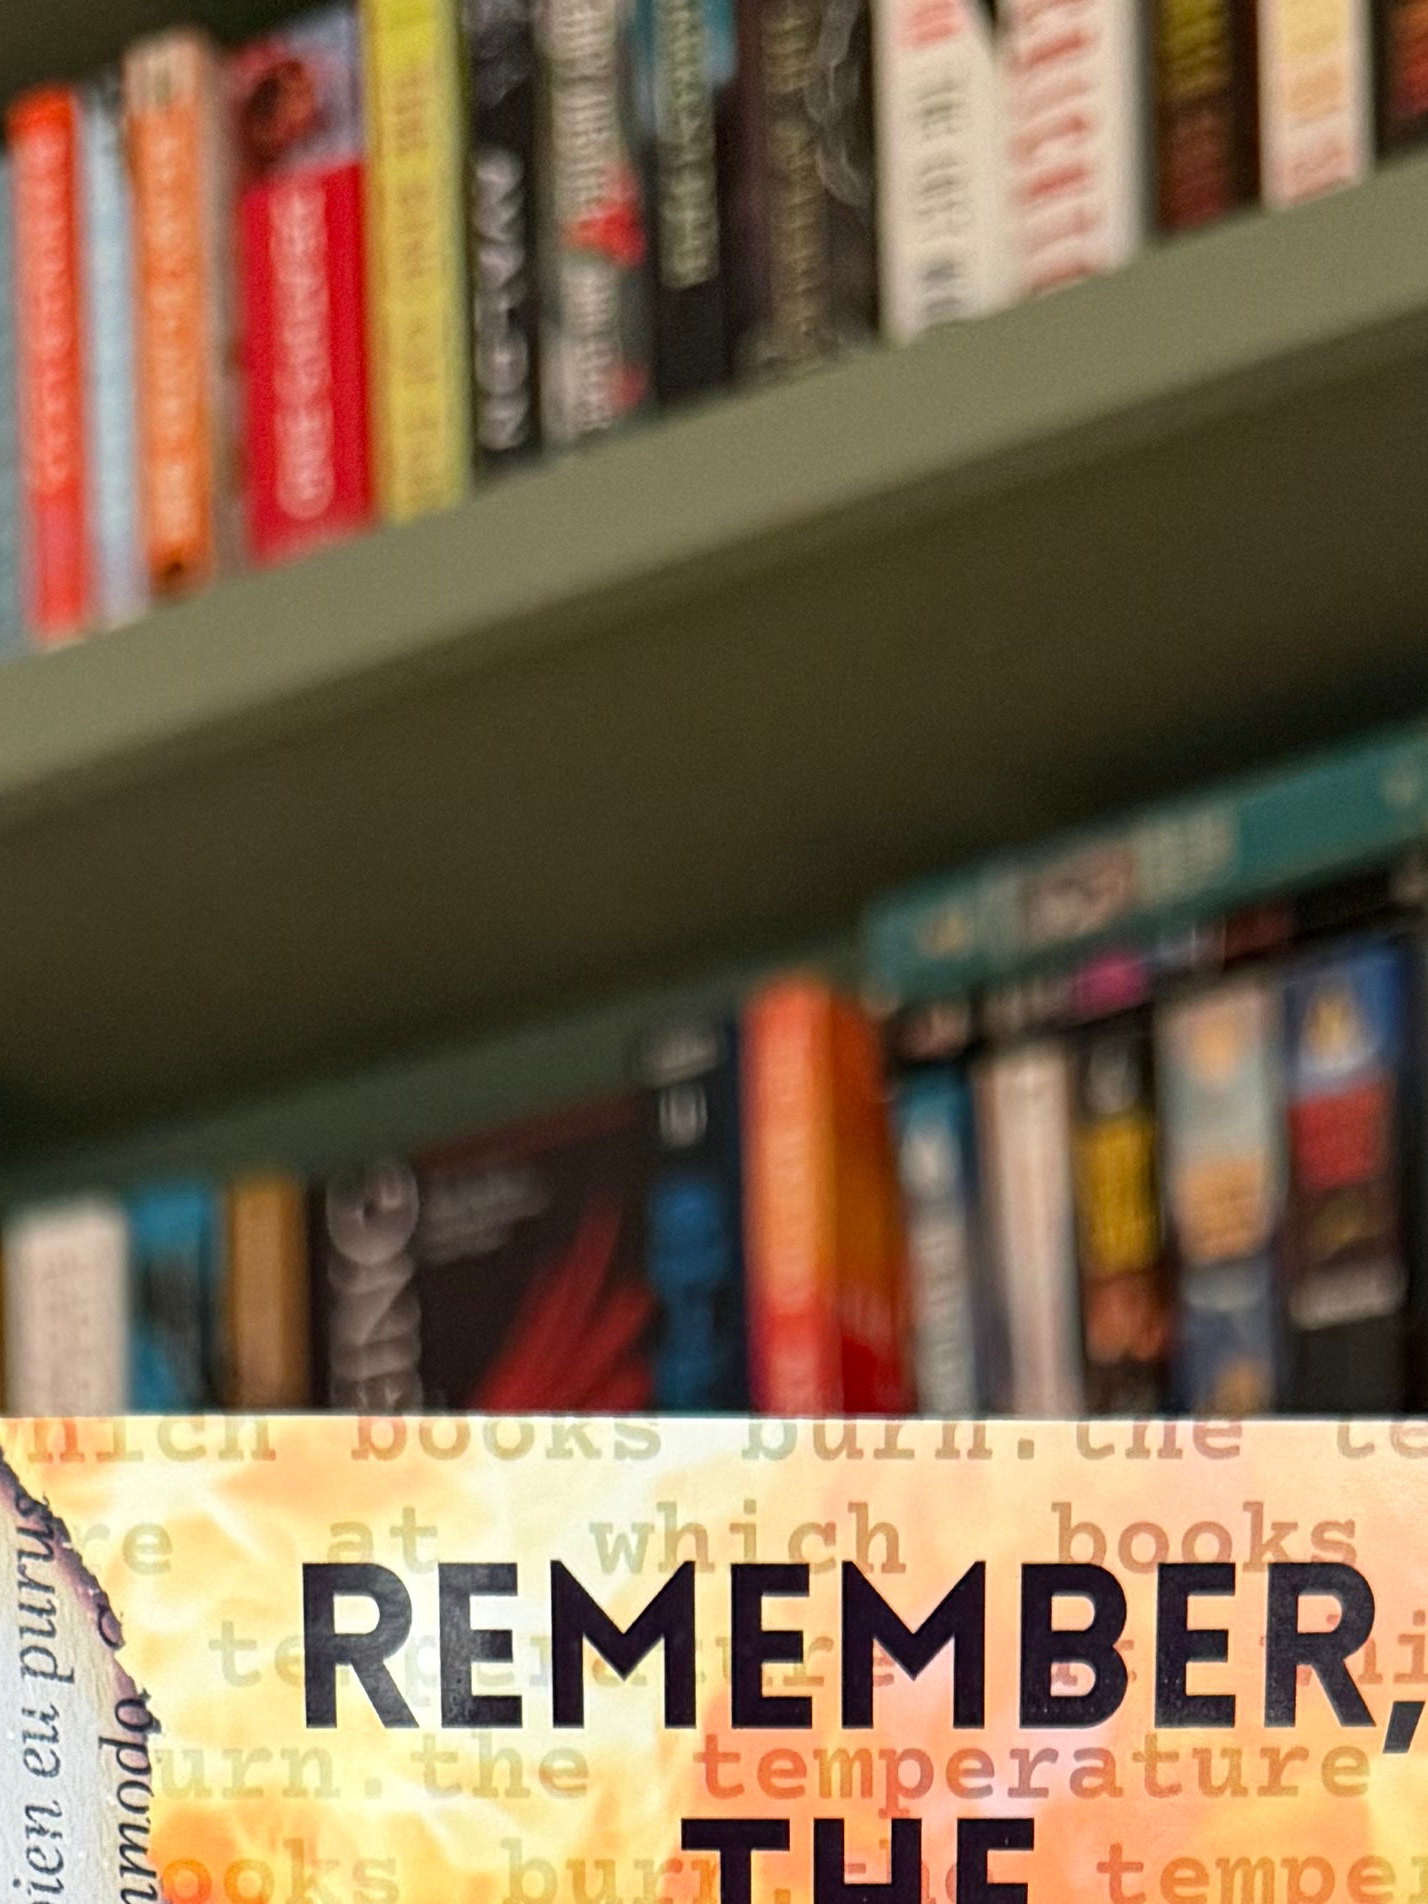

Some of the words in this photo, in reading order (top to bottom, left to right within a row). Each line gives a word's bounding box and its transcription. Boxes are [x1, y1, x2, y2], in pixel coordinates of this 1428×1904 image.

[328, 1506, 439, 1575] at
[589, 1502, 906, 1577] which
[1050, 1502, 1358, 1575] books
[301, 1560, 1426, 1755] REMEMBER,
[20, 1698, 61, 1780] eu
[693, 1729, 1369, 1820] temperature
